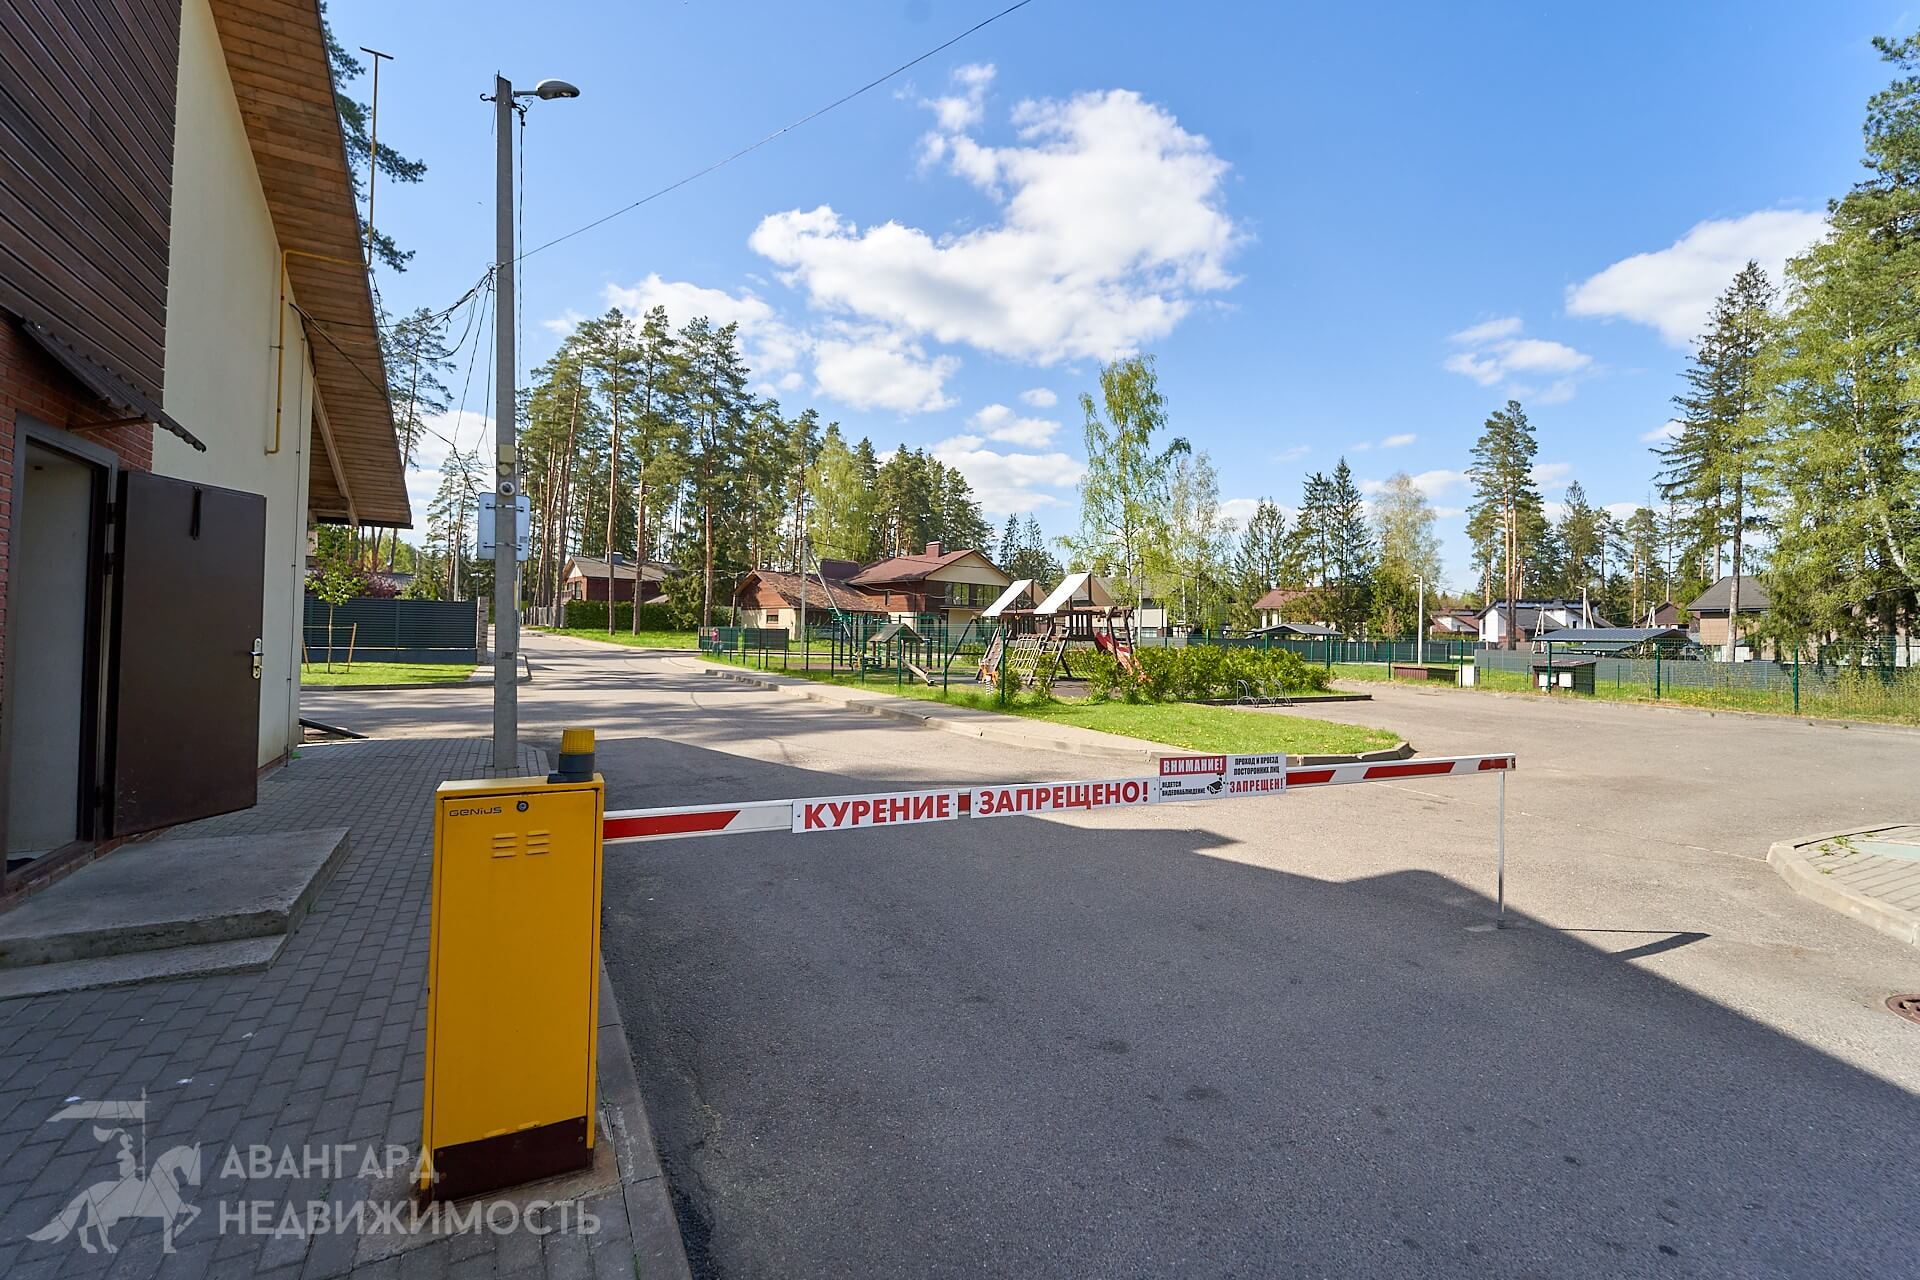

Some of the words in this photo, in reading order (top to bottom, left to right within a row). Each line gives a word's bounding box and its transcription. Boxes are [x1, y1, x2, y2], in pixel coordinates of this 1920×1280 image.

[1163, 758, 1223, 773] ВНИМАНИЕ!
[1235, 757, 1255, 766] ПРОХОД
[1255, 757, 1260, 765] И
[1261, 756, 1279, 765] ПРОЕЗД
[1234, 767, 1269, 776] ПОСТОРОННИХ
[1270, 766, 1280, 775] ЛИЦ
[1229, 778, 1283, 793] ЗАПРЕЩЕН!
[1162, 788, 1205, 796] ВИДЕОНАБЛЮДЕНИЕ
[804, 794, 950, 829] КУРЕНИЕ
[978, 781, 1148, 815] ЗАПРЕЩЕНО!
